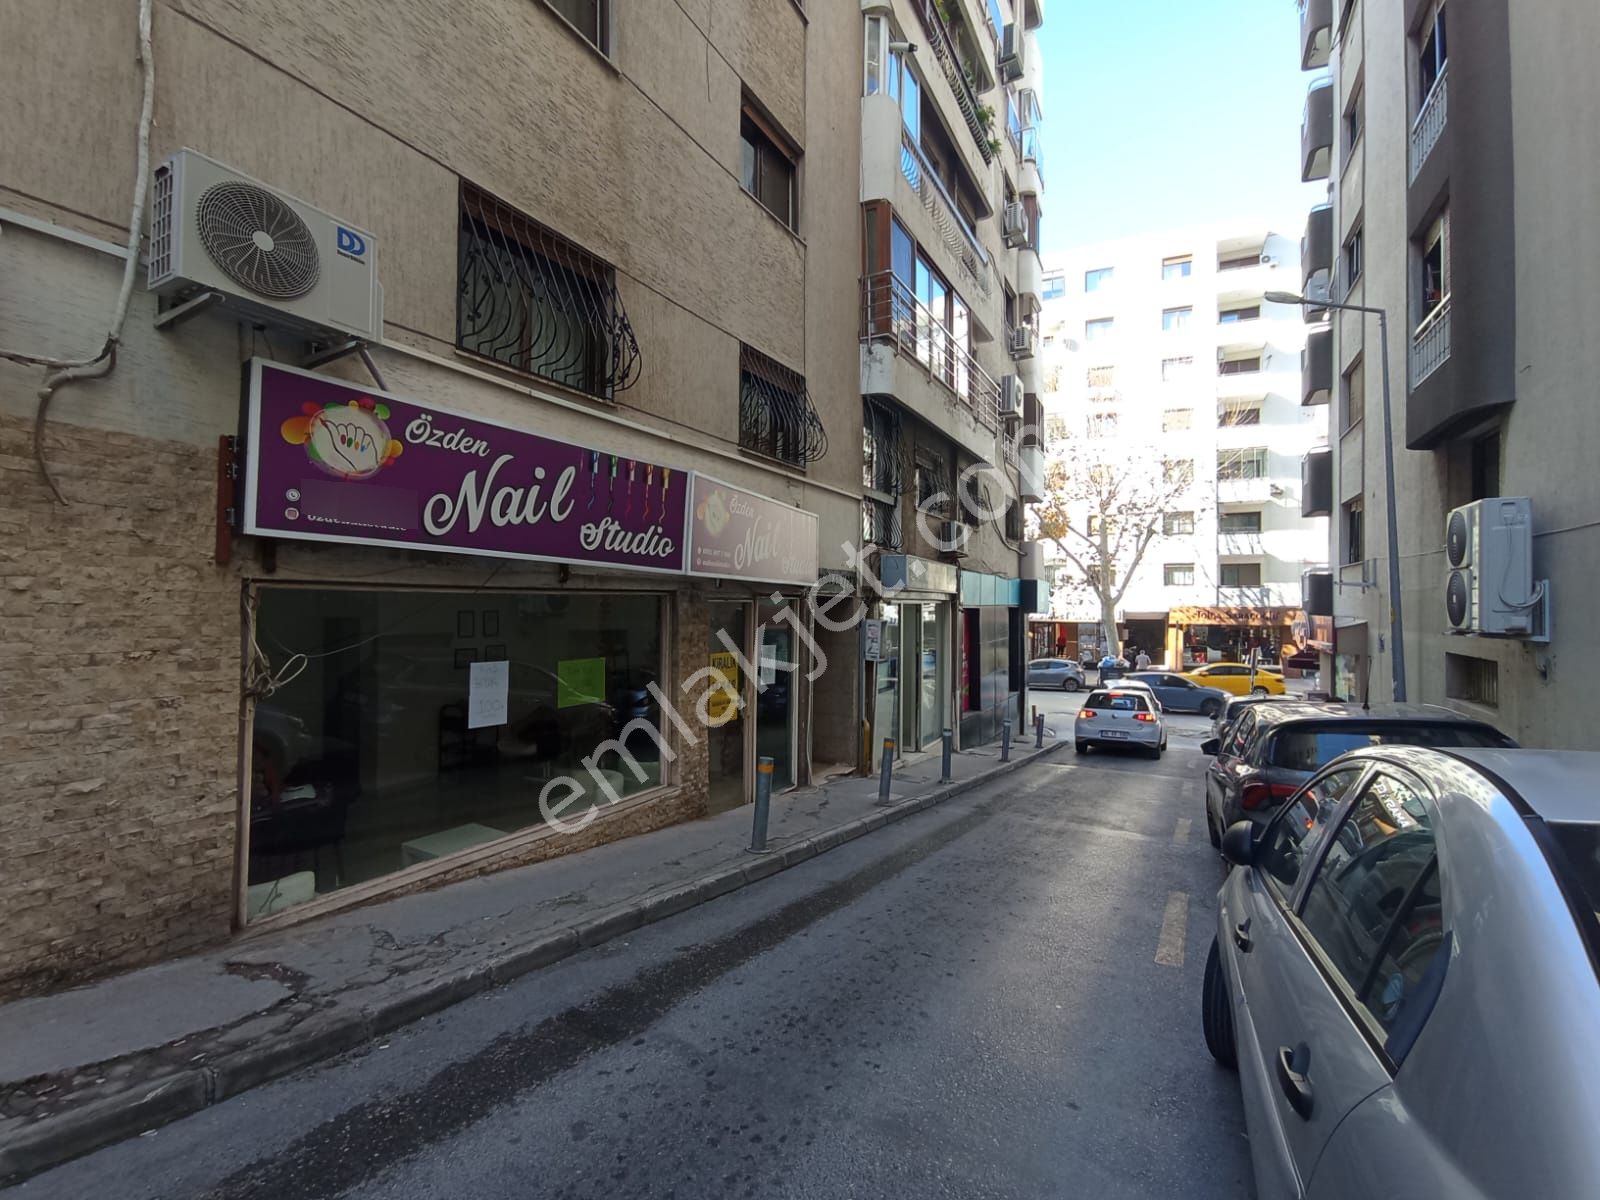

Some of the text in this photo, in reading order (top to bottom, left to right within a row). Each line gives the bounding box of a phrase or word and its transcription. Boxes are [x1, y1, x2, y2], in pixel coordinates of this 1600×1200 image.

[404, 413, 490, 457] Özden
[423, 454, 576, 537] Nail
[580, 516, 675, 558] Studio
[735, 514, 781, 571] Nail
